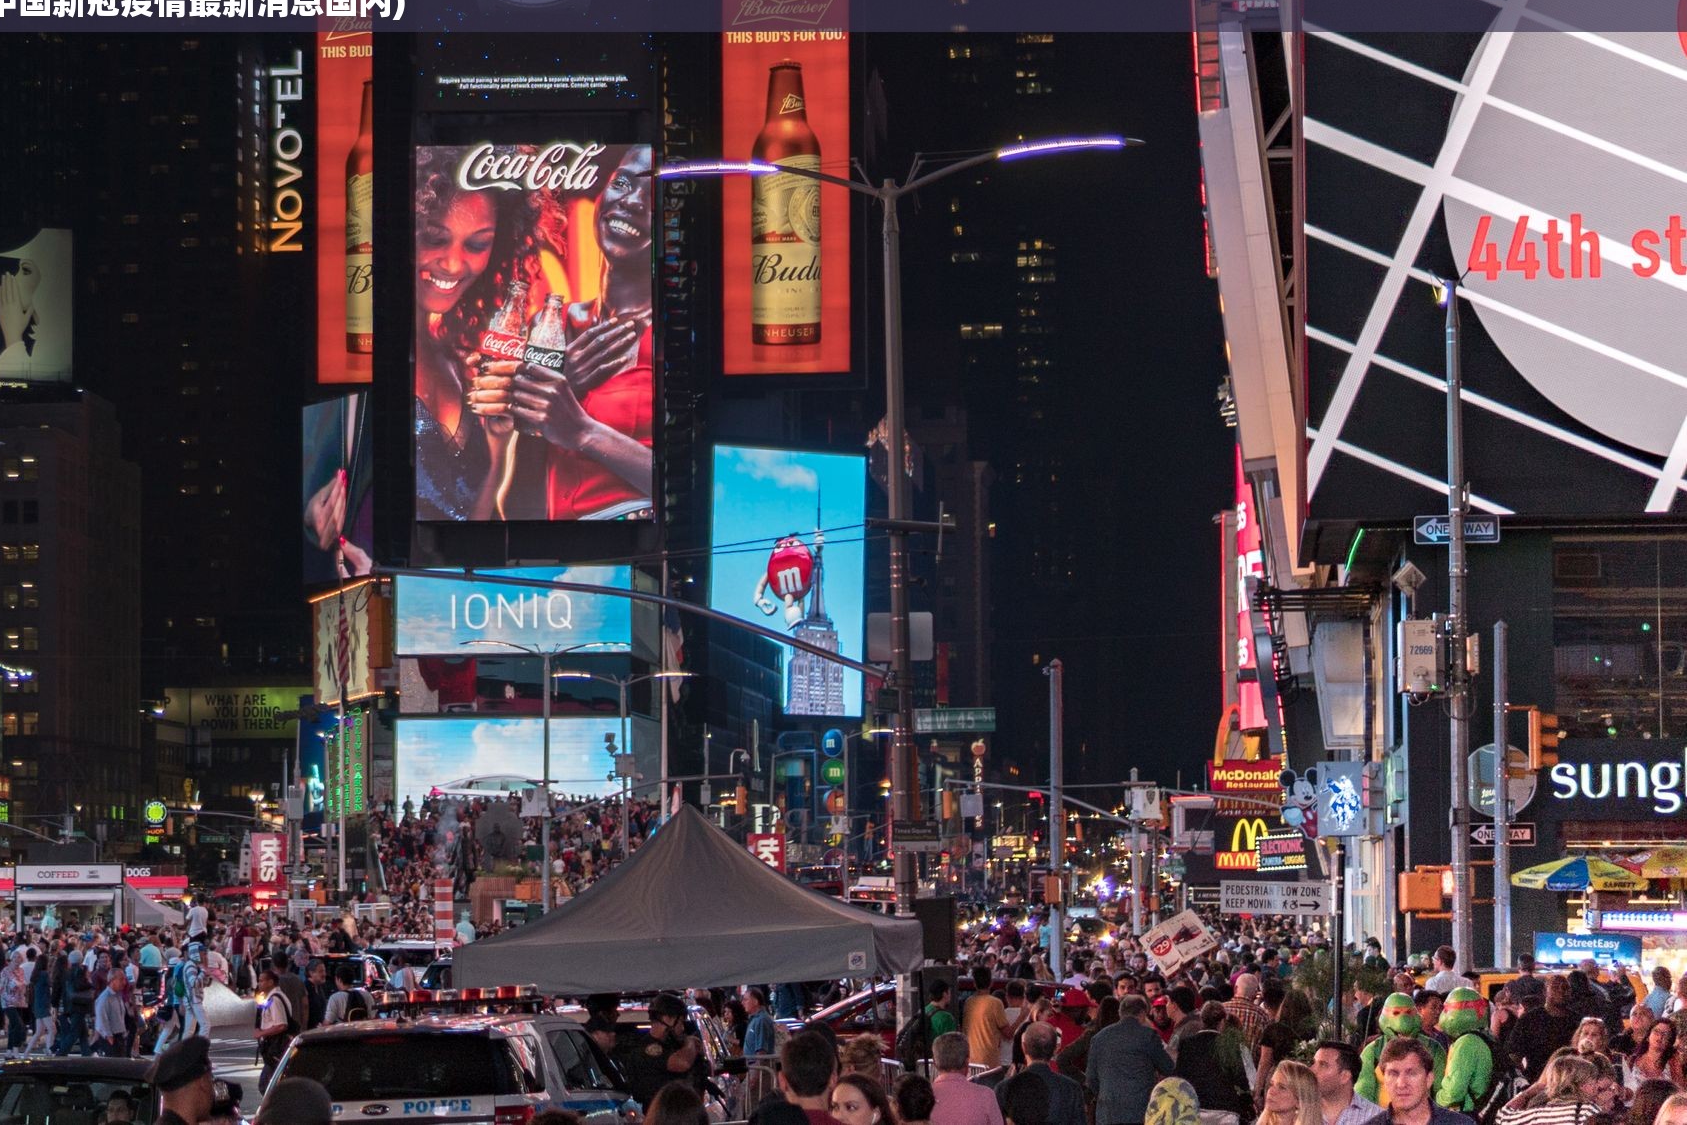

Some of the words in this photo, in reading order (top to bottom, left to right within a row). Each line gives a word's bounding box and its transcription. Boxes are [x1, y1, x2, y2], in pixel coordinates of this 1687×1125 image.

[726, 31, 753, 44] THIS
[756, 31, 791, 43] BUD'S
[794, 29, 816, 42] FOR
[819, 27, 846, 41] YOU.
[321, 46, 347, 59] THIS
[270, 49, 304, 253] NOVOTEL
[459, 142, 606, 191] Coca-Cola
[1468, 214, 1602, 281] 44th
[484, 331, 524, 360] Coca-Cola
[525, 345, 563, 371] Coca-Cola
[1426, 524, 1450, 535] ONE
[1464, 523, 1491, 534] WAY
[451, 591, 574, 631] IONIQ
[205, 694, 240, 706] WHAT
[243, 694, 266, 706] ARE
[214, 706, 239, 718] YOU
[243, 706, 281, 718] DOING
[201, 719, 240, 731] DOWN
[243, 718, 287, 731] THERE?
[935, 714, 949, 729] W
[957, 714, 976, 729] 45
[1226, 781, 1279, 789] Restaurant
[1261, 838, 1305, 855] ELECTRONIC
[260, 837, 278, 883] tkts
[37, 870, 80, 879] COFFEED
[126, 867, 151, 877] DOGS
[1301, 887, 1322, 898] ZONE
[1226, 898, 1246, 908] KEEP
[1567, 937, 1620, 950] StreetEasy
[403, 1099, 472, 1114] POLICE
